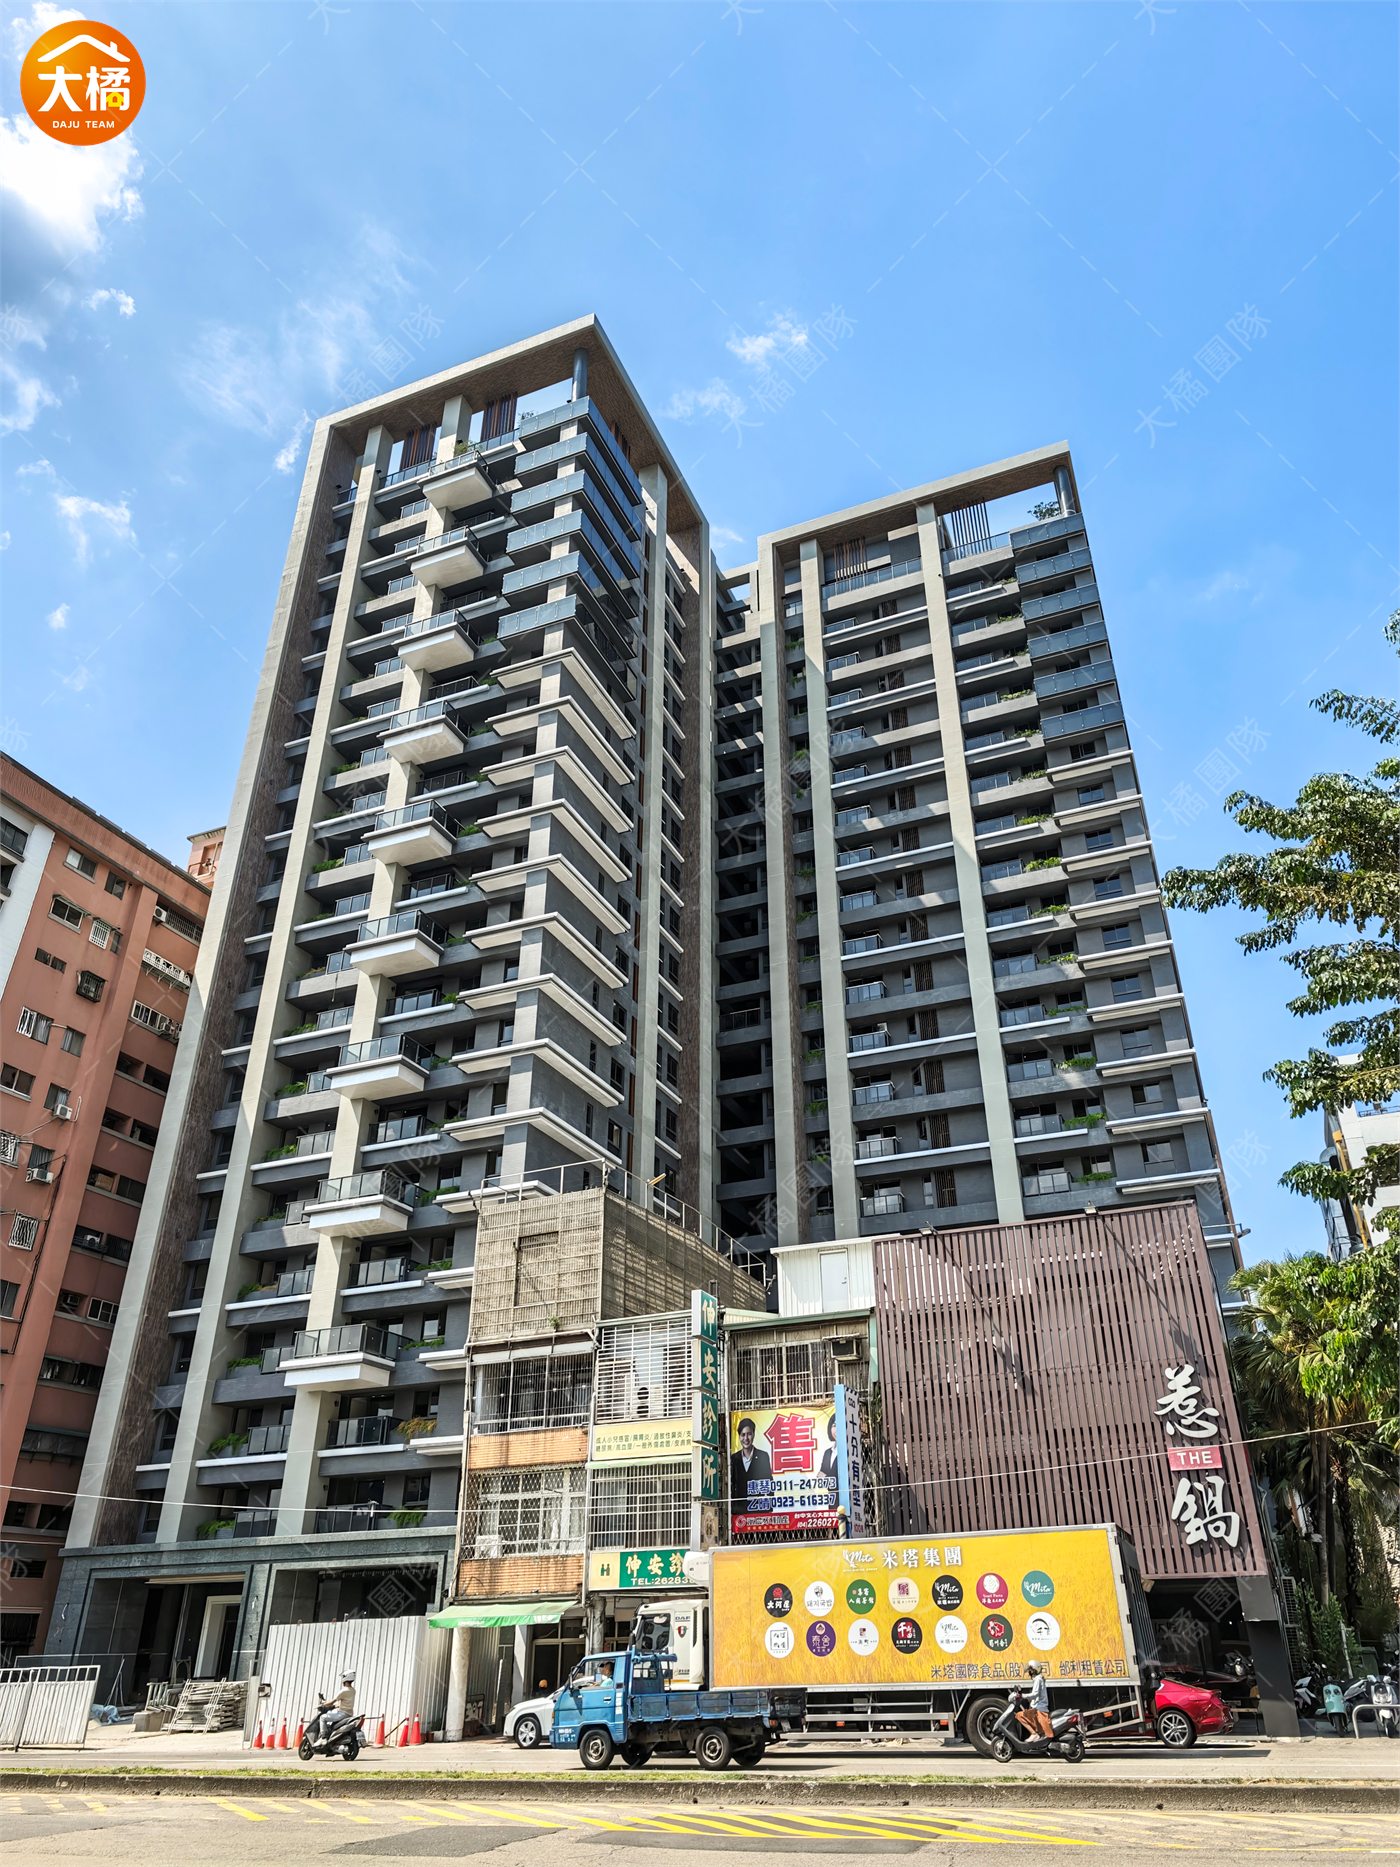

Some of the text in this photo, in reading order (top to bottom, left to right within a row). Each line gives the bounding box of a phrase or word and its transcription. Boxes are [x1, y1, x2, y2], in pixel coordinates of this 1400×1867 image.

[702, 1298, 717, 1495] 伸安診所
[1154, 1364, 1220, 1438] 惹
[763, 1412, 817, 1475] 售
[1177, 1451, 1213, 1465] THE
[798, 1518, 838, 1529] (04)226027
[1171, 1475, 1240, 1548] 鍋
[882, 1546, 962, 1569] 米塔集團
[931, 1661, 1050, 1679] 米塔國際食品(股)司
